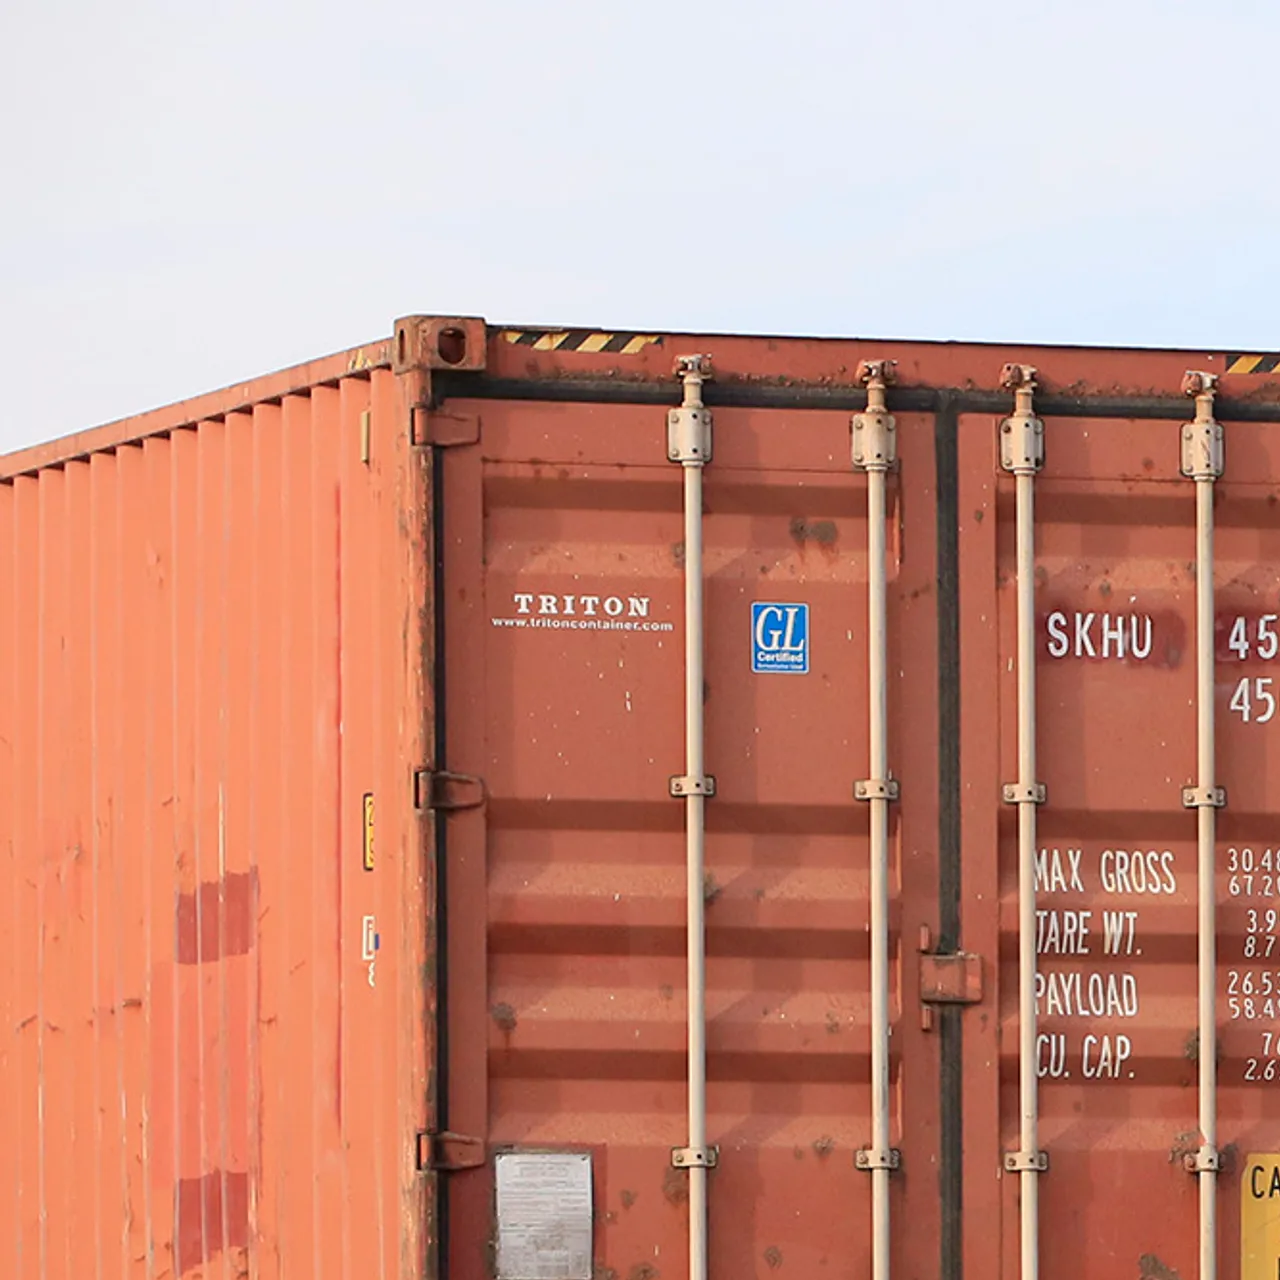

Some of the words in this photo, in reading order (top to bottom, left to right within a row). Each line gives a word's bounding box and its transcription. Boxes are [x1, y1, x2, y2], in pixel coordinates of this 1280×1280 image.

[491, 616, 674, 632] www.tritoncontainer.com
[514, 594, 650, 617] TRITON
[756, 606, 804, 651] GL
[1047, 611, 1152, 658] SKHU
[757, 651, 804, 662] Certified
[1034, 849, 1085, 893] MAX
[1101, 850, 1177, 895] GROSS
[1036, 910, 1092, 954] TARE
[1103, 911, 1142, 955] WT.
[1034, 973, 1139, 1017] PAYLOAD
[1035, 1033, 1070, 1077] CU.
[1082, 1034, 1136, 1078] CAP.
